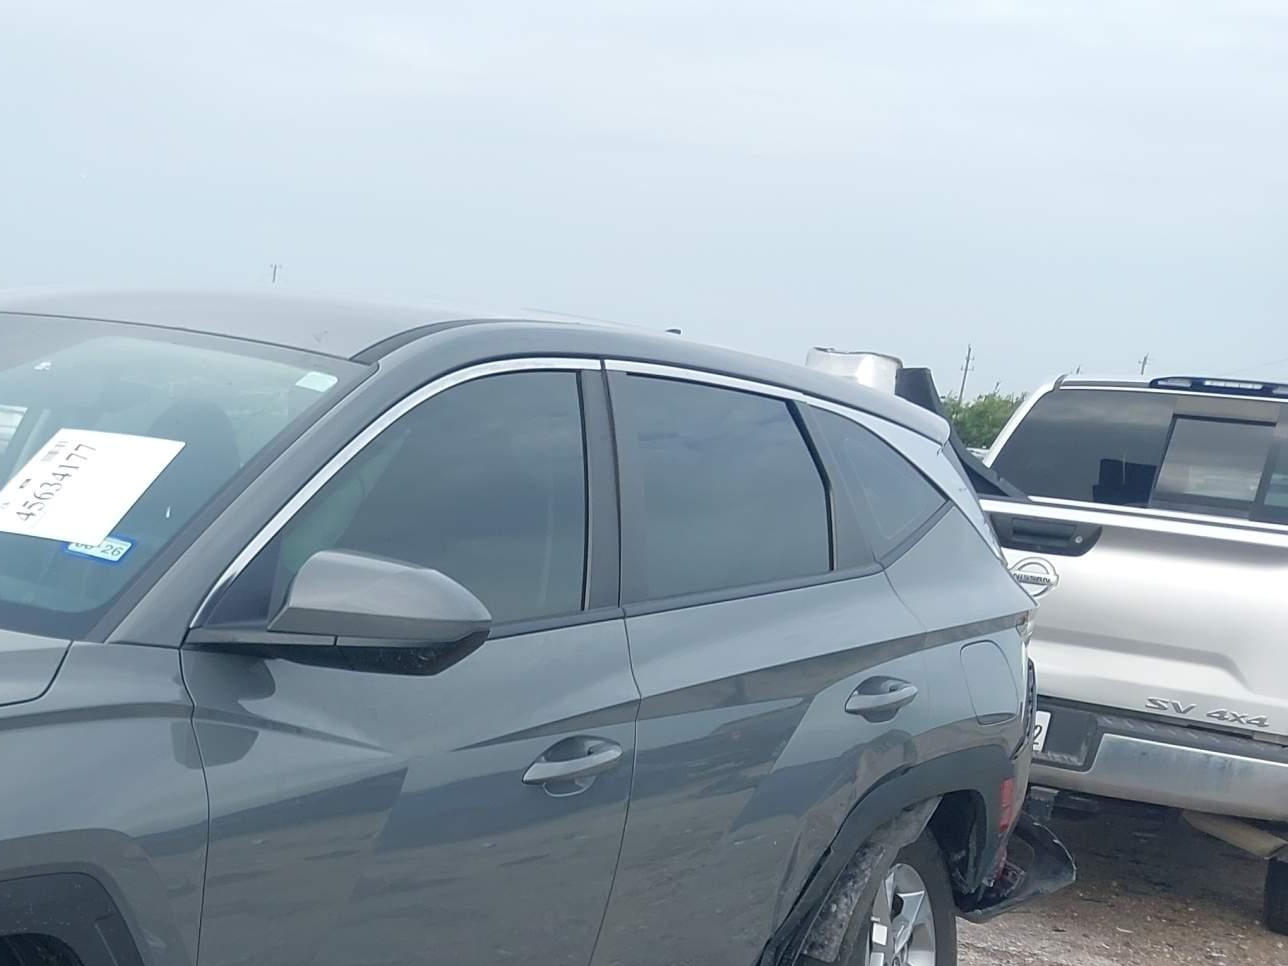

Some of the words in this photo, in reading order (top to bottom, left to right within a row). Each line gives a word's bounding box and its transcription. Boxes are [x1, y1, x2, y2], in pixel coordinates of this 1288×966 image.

[15, 443, 97, 522] 45634177
[100, 544, 124, 557] 26
[1144, 696, 1197, 714] SV
